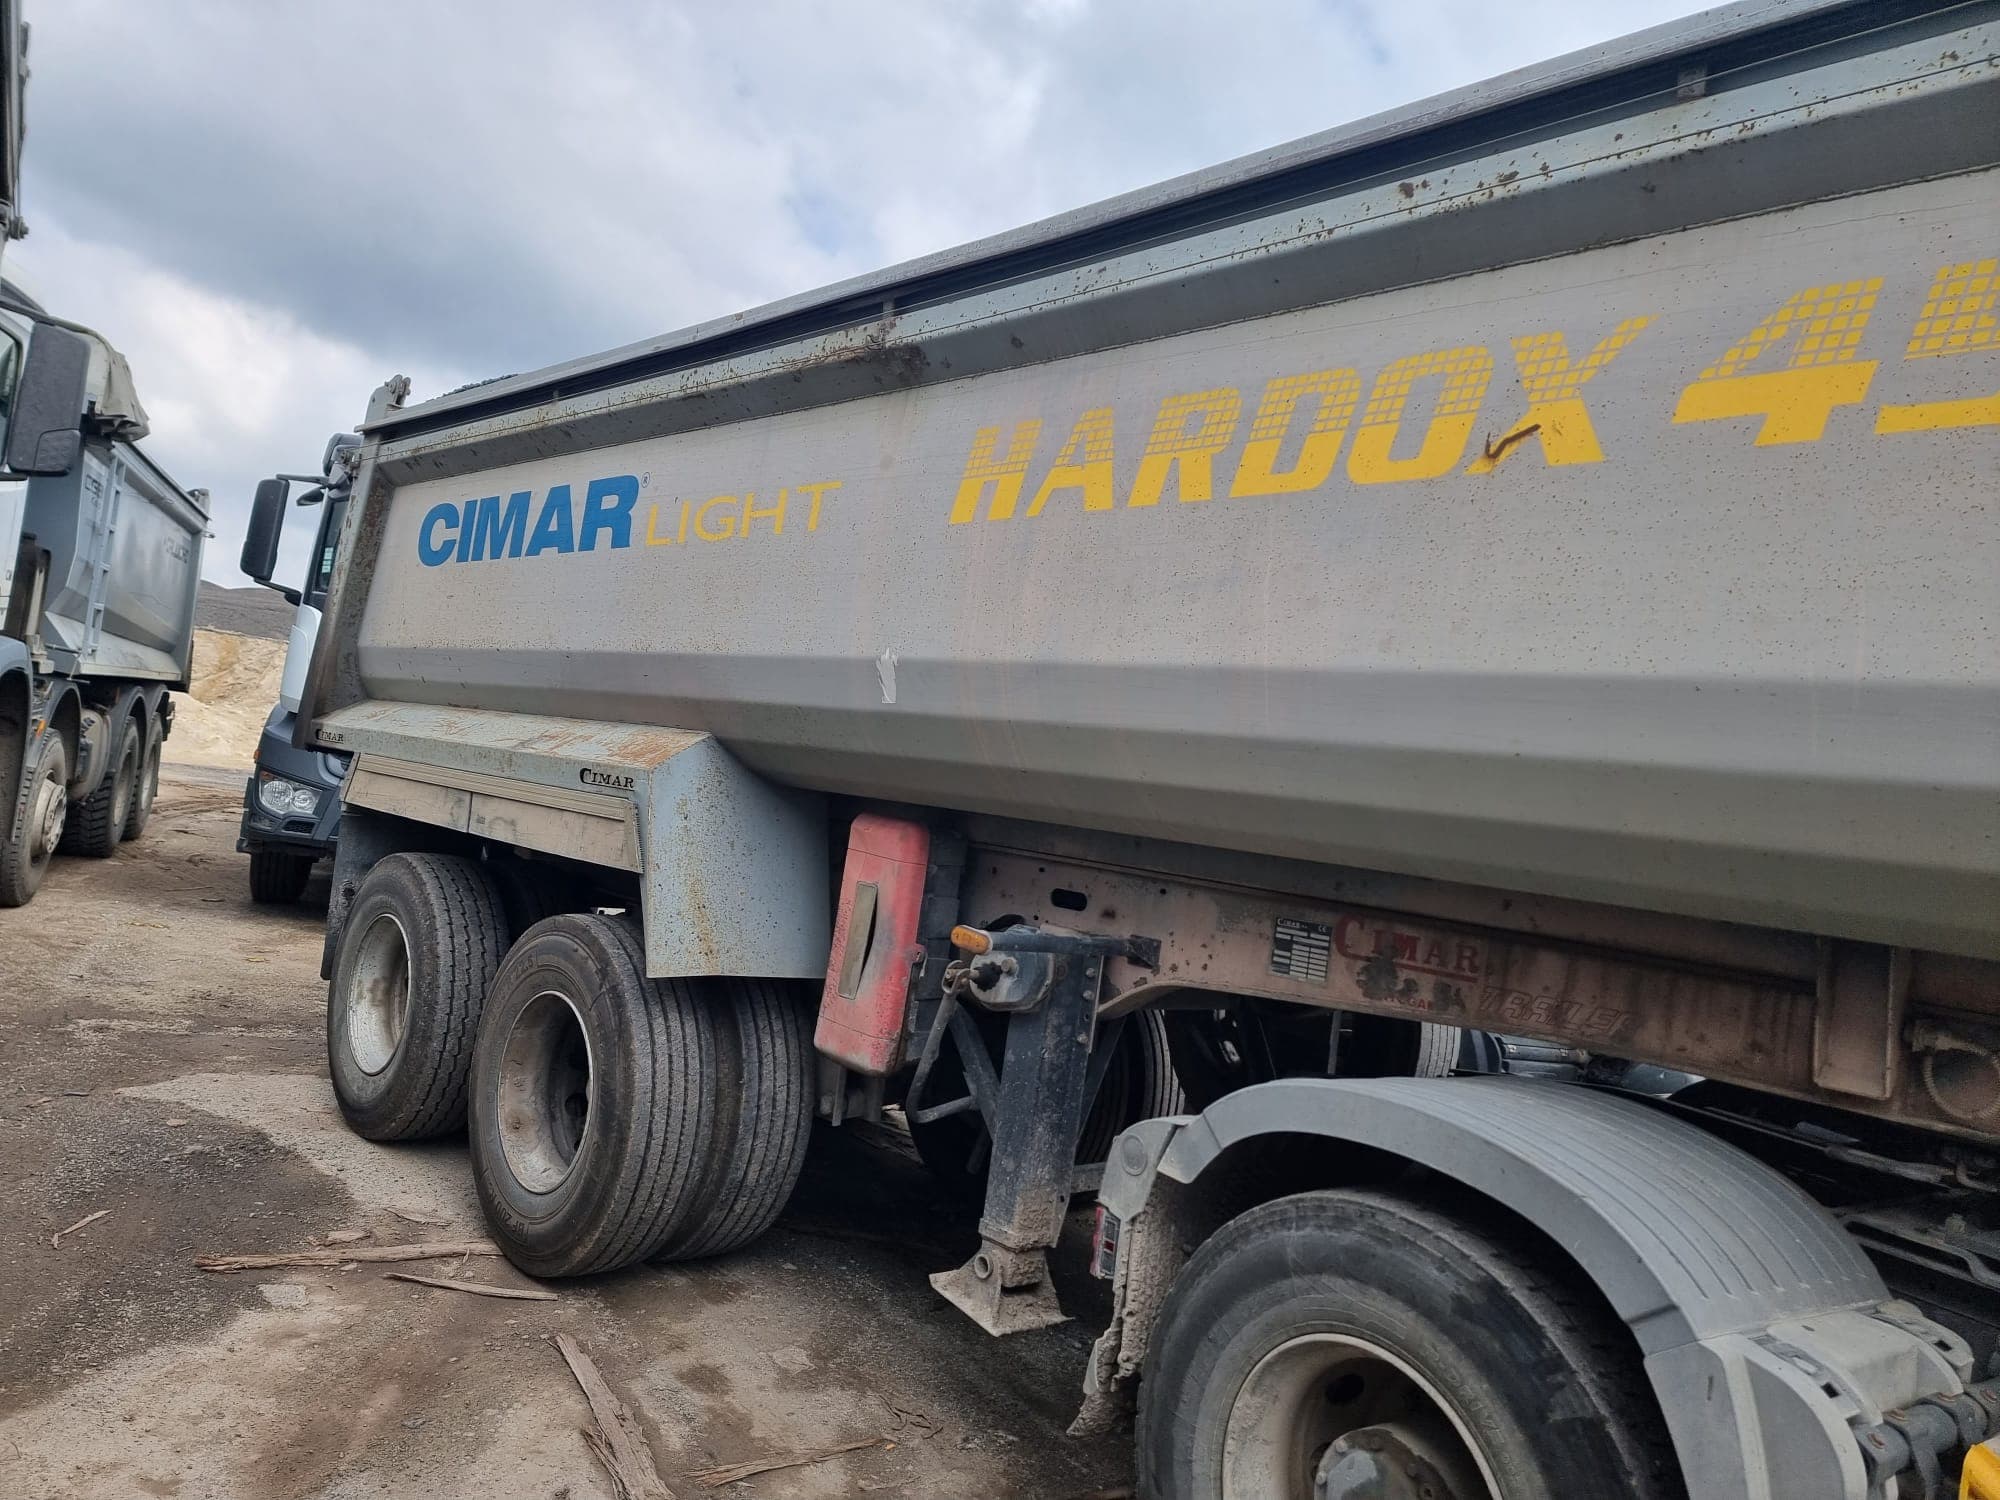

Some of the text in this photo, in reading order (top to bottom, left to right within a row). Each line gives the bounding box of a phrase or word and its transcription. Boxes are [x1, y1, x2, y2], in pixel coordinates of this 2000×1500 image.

[948, 314, 1660, 525] HARDOX
[418, 475, 843, 567] CIMAR LIGHT
[580, 768, 635, 791] CIMAR
[1334, 911, 1481, 983] CIMAR
